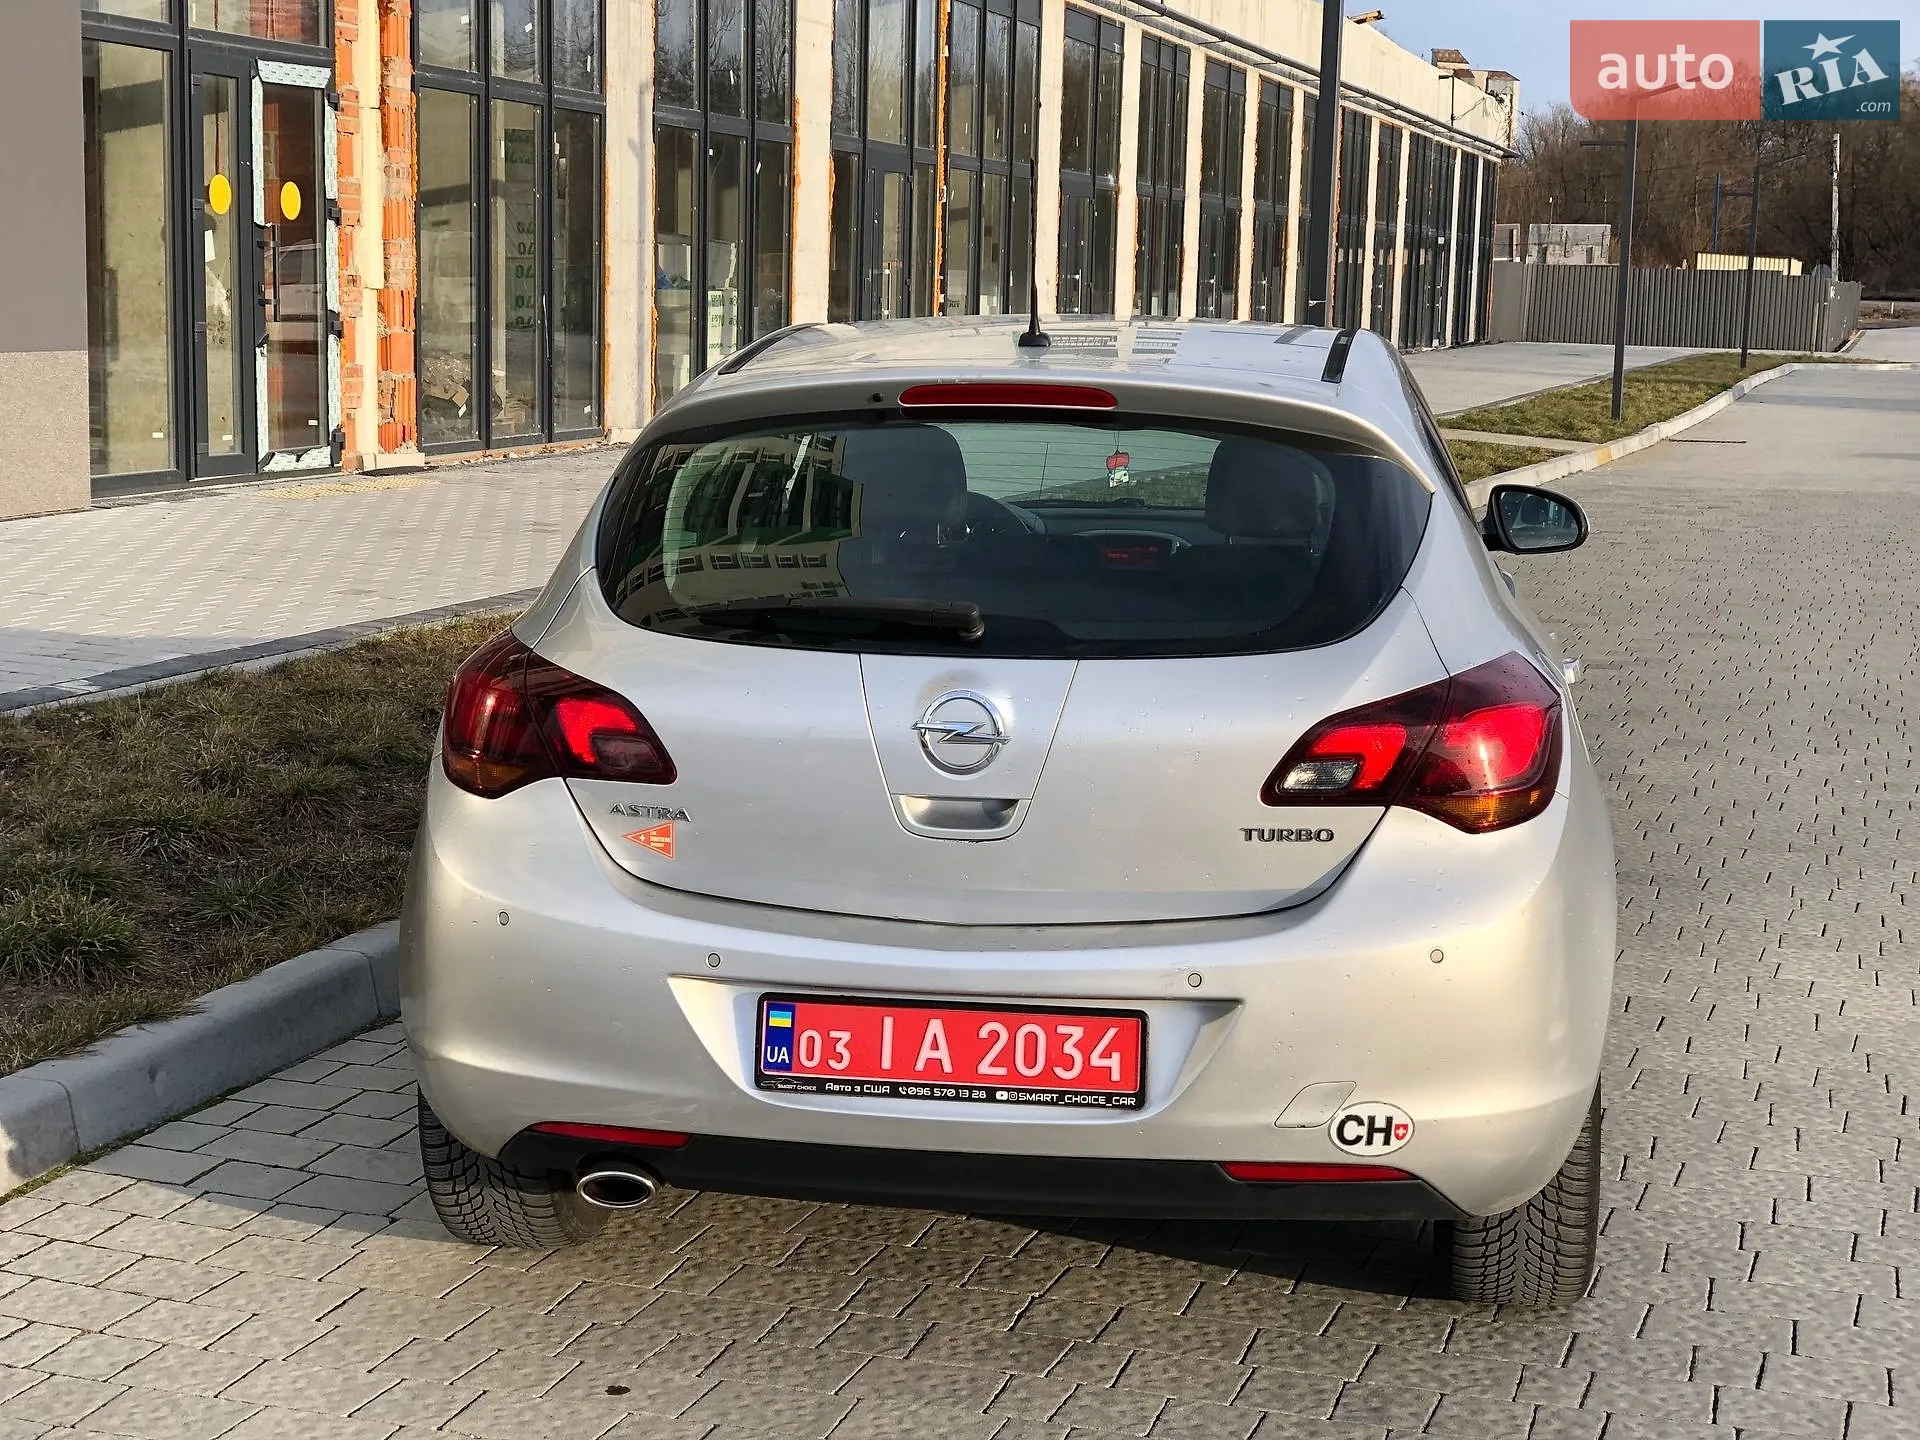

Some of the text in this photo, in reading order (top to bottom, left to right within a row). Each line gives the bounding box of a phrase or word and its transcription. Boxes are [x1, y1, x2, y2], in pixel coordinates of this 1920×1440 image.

[610, 802, 692, 822] ASTRA
[1239, 827, 1335, 842] TURBO
[766, 1045, 789, 1064] UA
[798, 1029, 852, 1071] 03
[976, 1021, 1121, 1082] 2034
[825, 1082, 851, 1092] Авто
[863, 1085, 890, 1094] США
[907, 1087, 986, 1099] 096 570 13 28
[1336, 1114, 1394, 1146] CH
